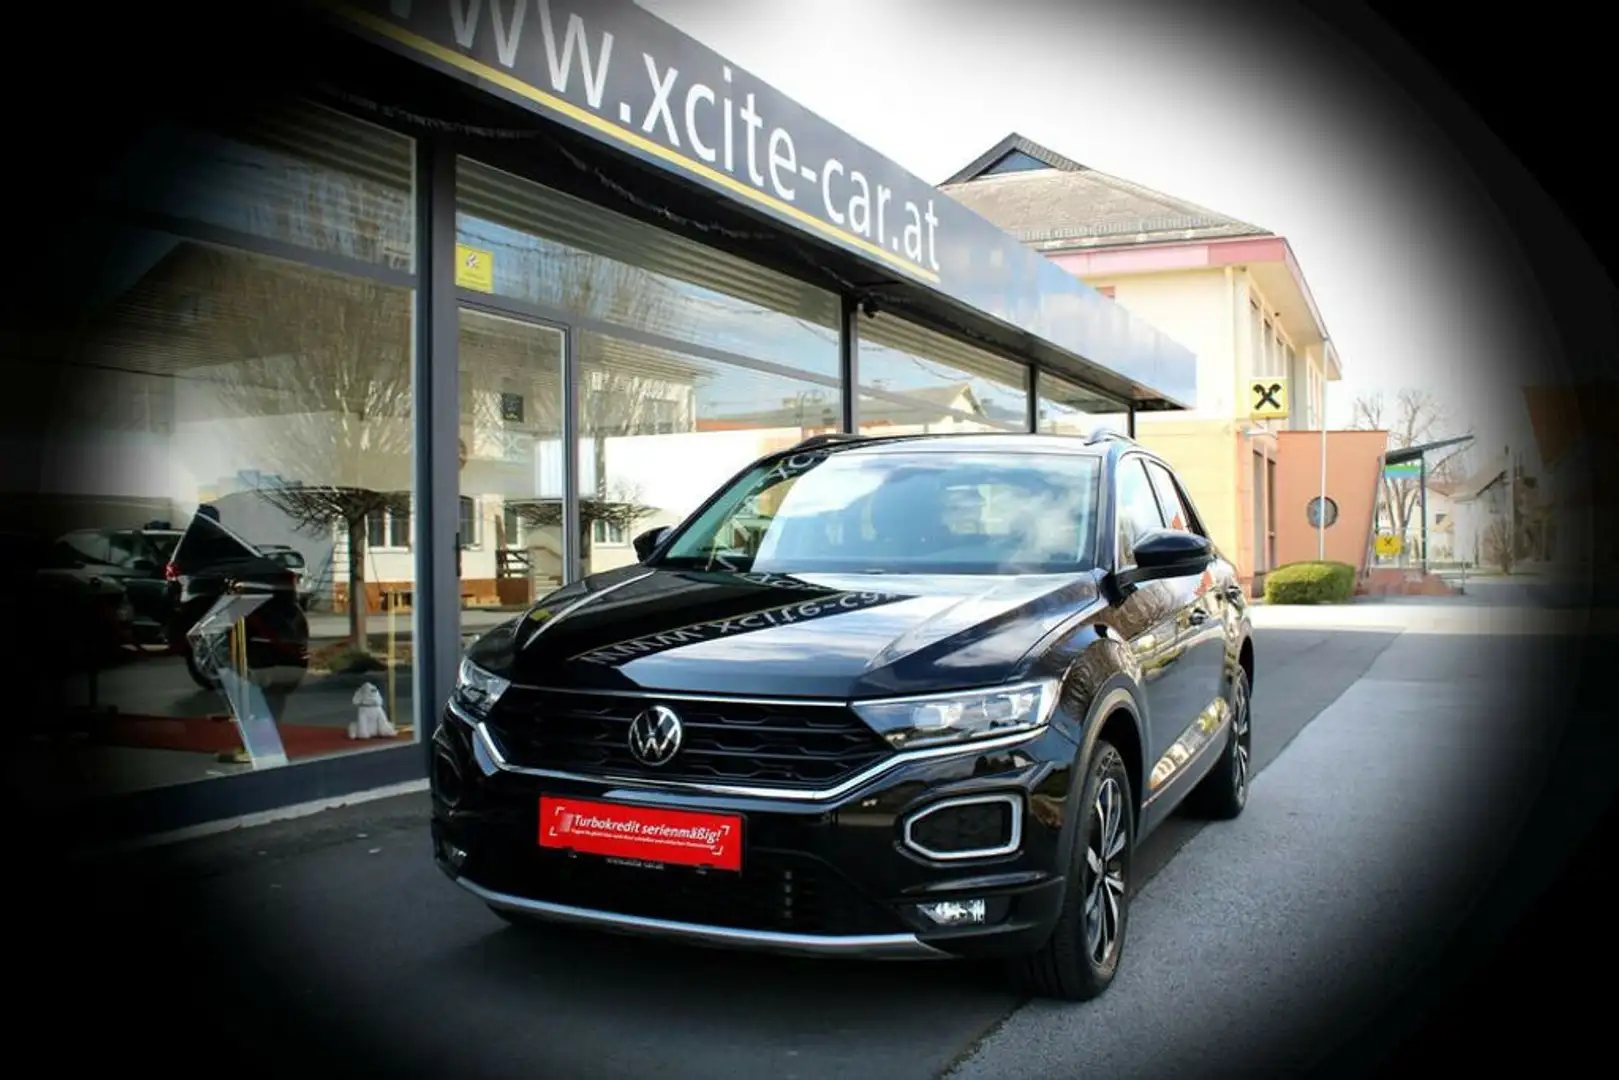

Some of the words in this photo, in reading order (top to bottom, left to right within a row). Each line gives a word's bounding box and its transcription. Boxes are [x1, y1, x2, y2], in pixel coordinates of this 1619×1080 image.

[390, 0, 939, 271] ww.xcite-car.at
[574, 814, 640, 834] Turbokredit
[641, 824, 721, 844] serienmäßig!
